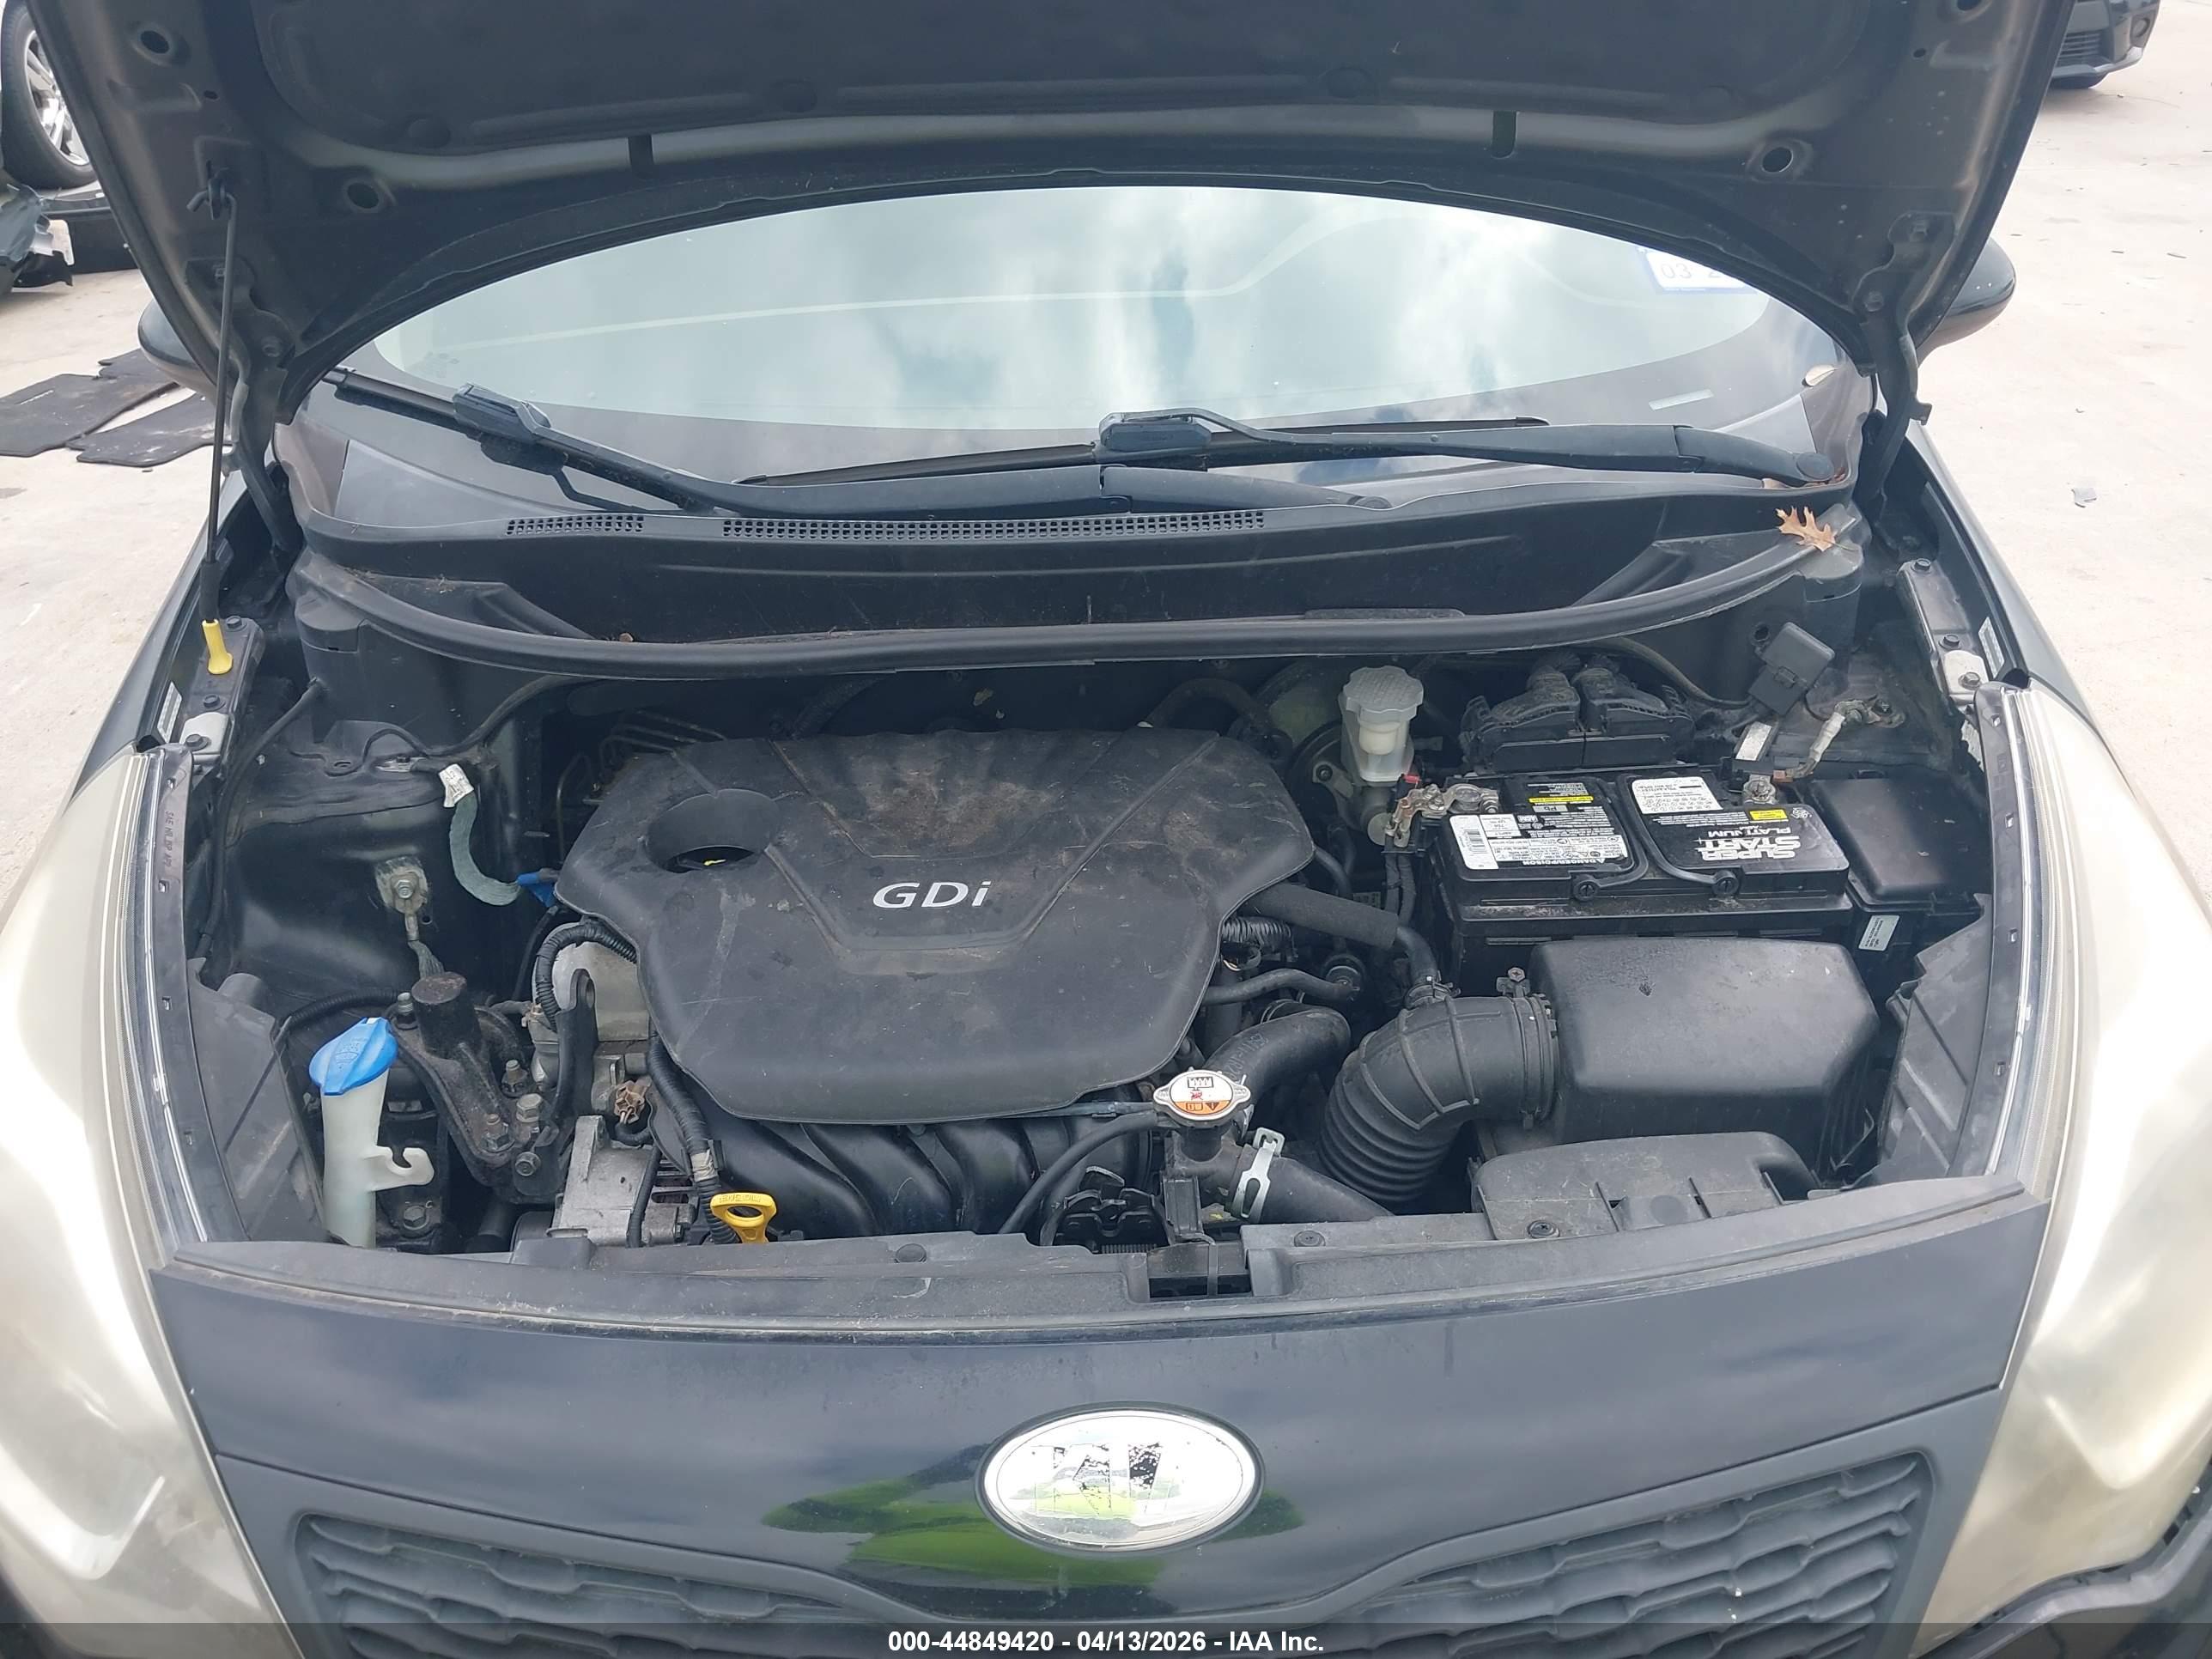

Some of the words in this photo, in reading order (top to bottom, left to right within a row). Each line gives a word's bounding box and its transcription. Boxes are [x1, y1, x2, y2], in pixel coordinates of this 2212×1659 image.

[1660, 263, 1692, 280] 03
[1708, 826, 1792, 838] PLATINUM
[1704, 836, 1801, 850] START
[1701, 848, 1796, 861] SUPER
[873, 881, 992, 908] GDi
